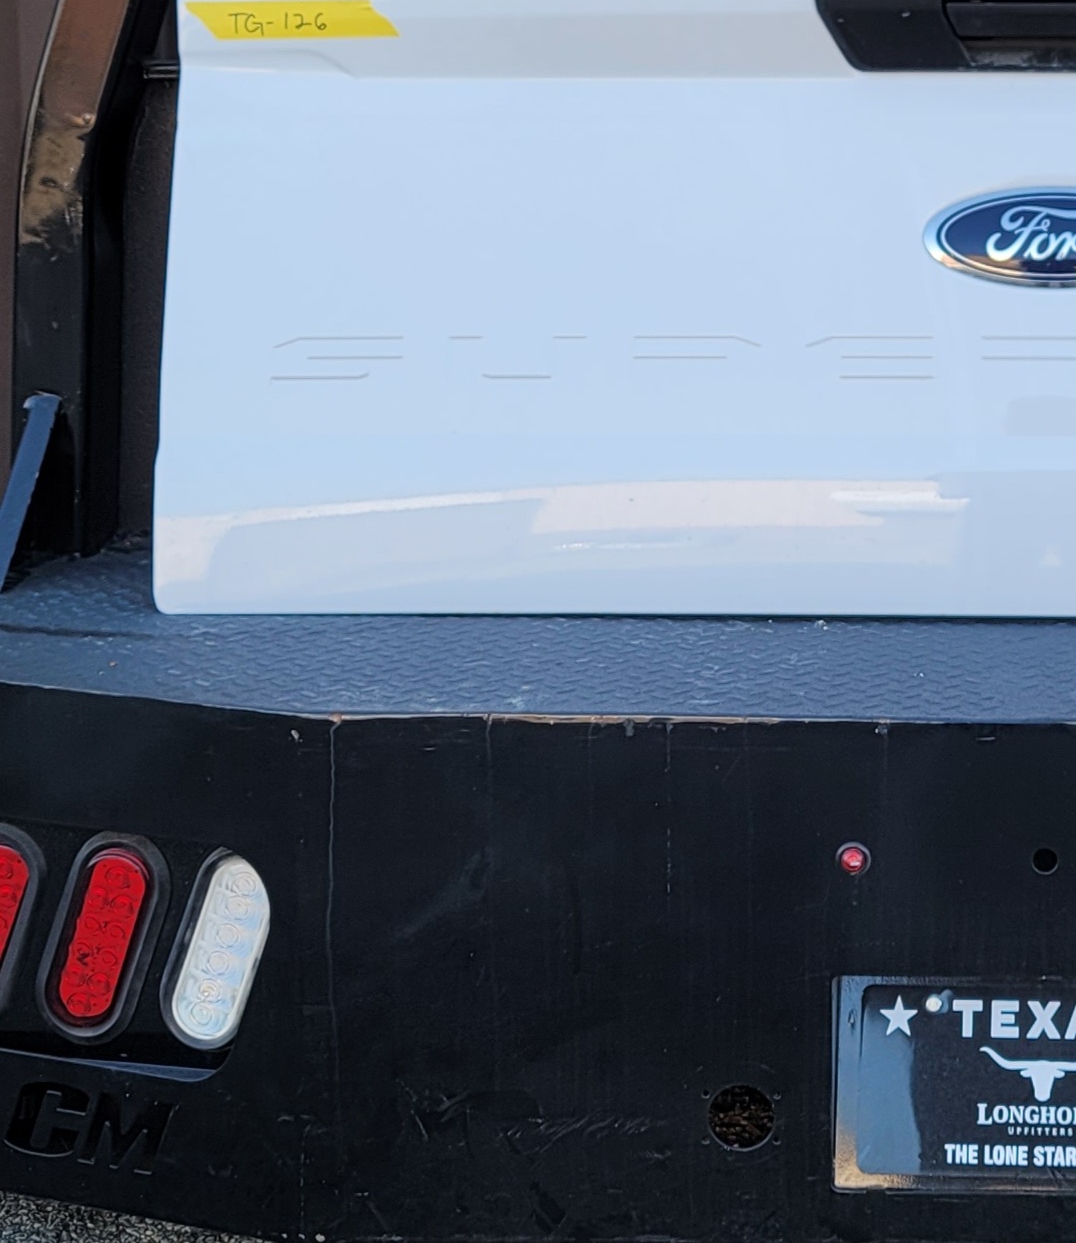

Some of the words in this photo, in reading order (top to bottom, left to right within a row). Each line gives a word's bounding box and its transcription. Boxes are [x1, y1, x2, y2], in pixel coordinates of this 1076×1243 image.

[227, 12, 328, 37] TG-126
[3, 1080, 177, 1175] CM
[1007, 1126, 1074, 1137] UPFITTERS
[944, 1142, 979, 1165] THE
[983, 1143, 1029, 1167] LONE
